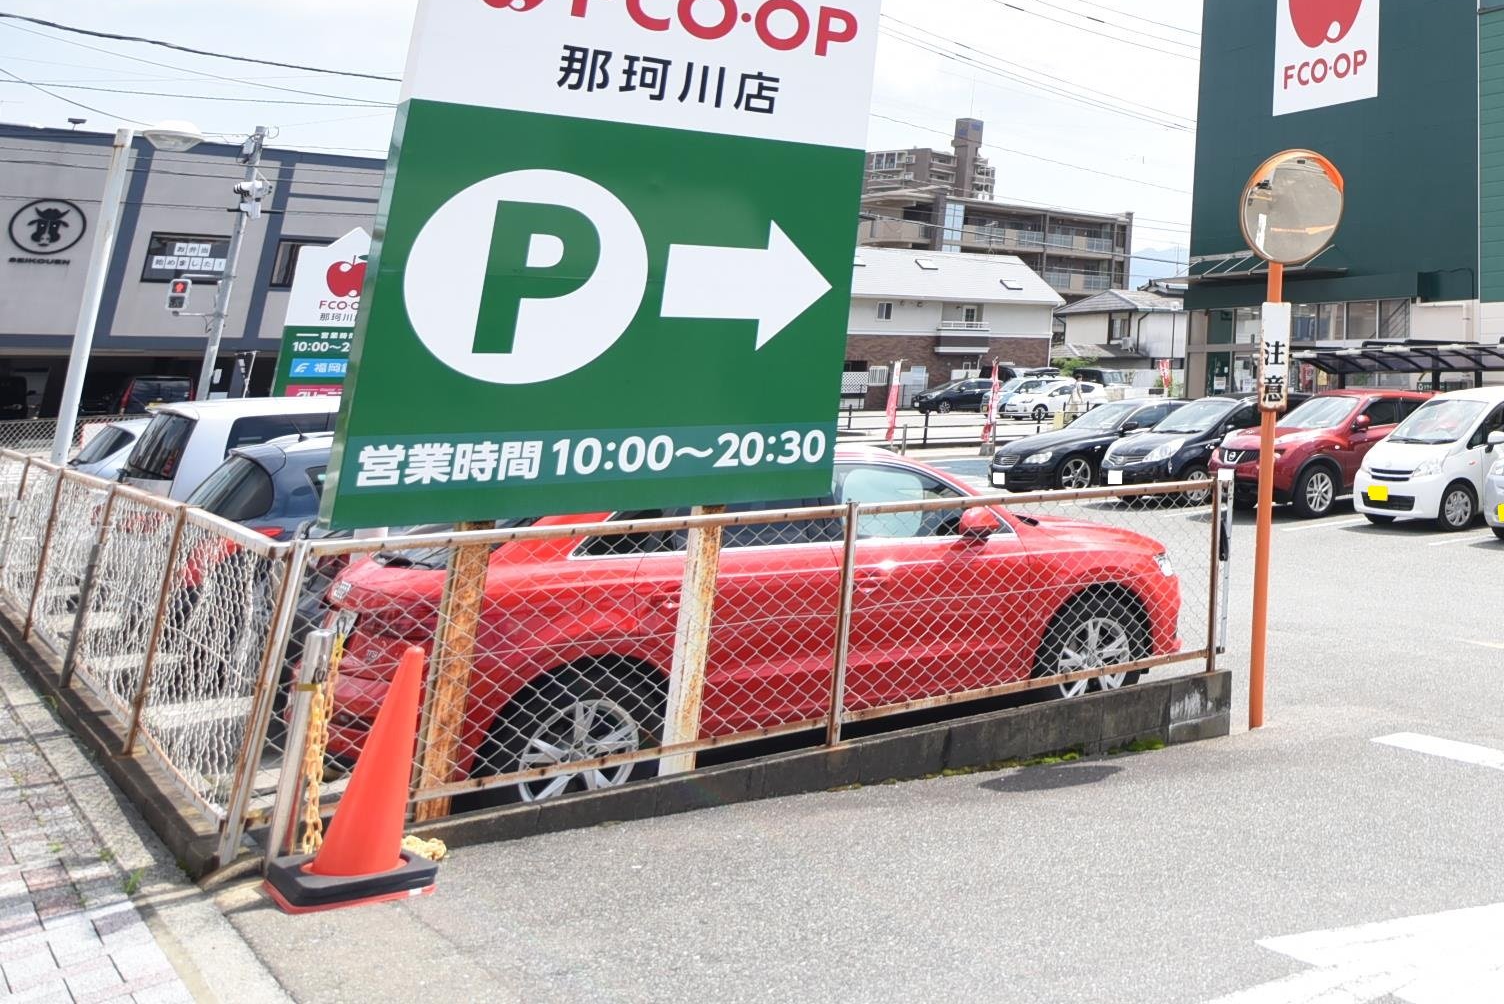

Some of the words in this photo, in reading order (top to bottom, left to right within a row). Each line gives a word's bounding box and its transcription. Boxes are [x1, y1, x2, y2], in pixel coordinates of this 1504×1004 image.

[556, 44, 780, 115] 那珂川店
[472, 199, 601, 354] P
[320, 313, 357, 321] 那珂川
[293, 341, 351, 352] 10:00～2
[1263, 340, 1285, 402] 注意
[356, 439, 543, 487] 営業時間
